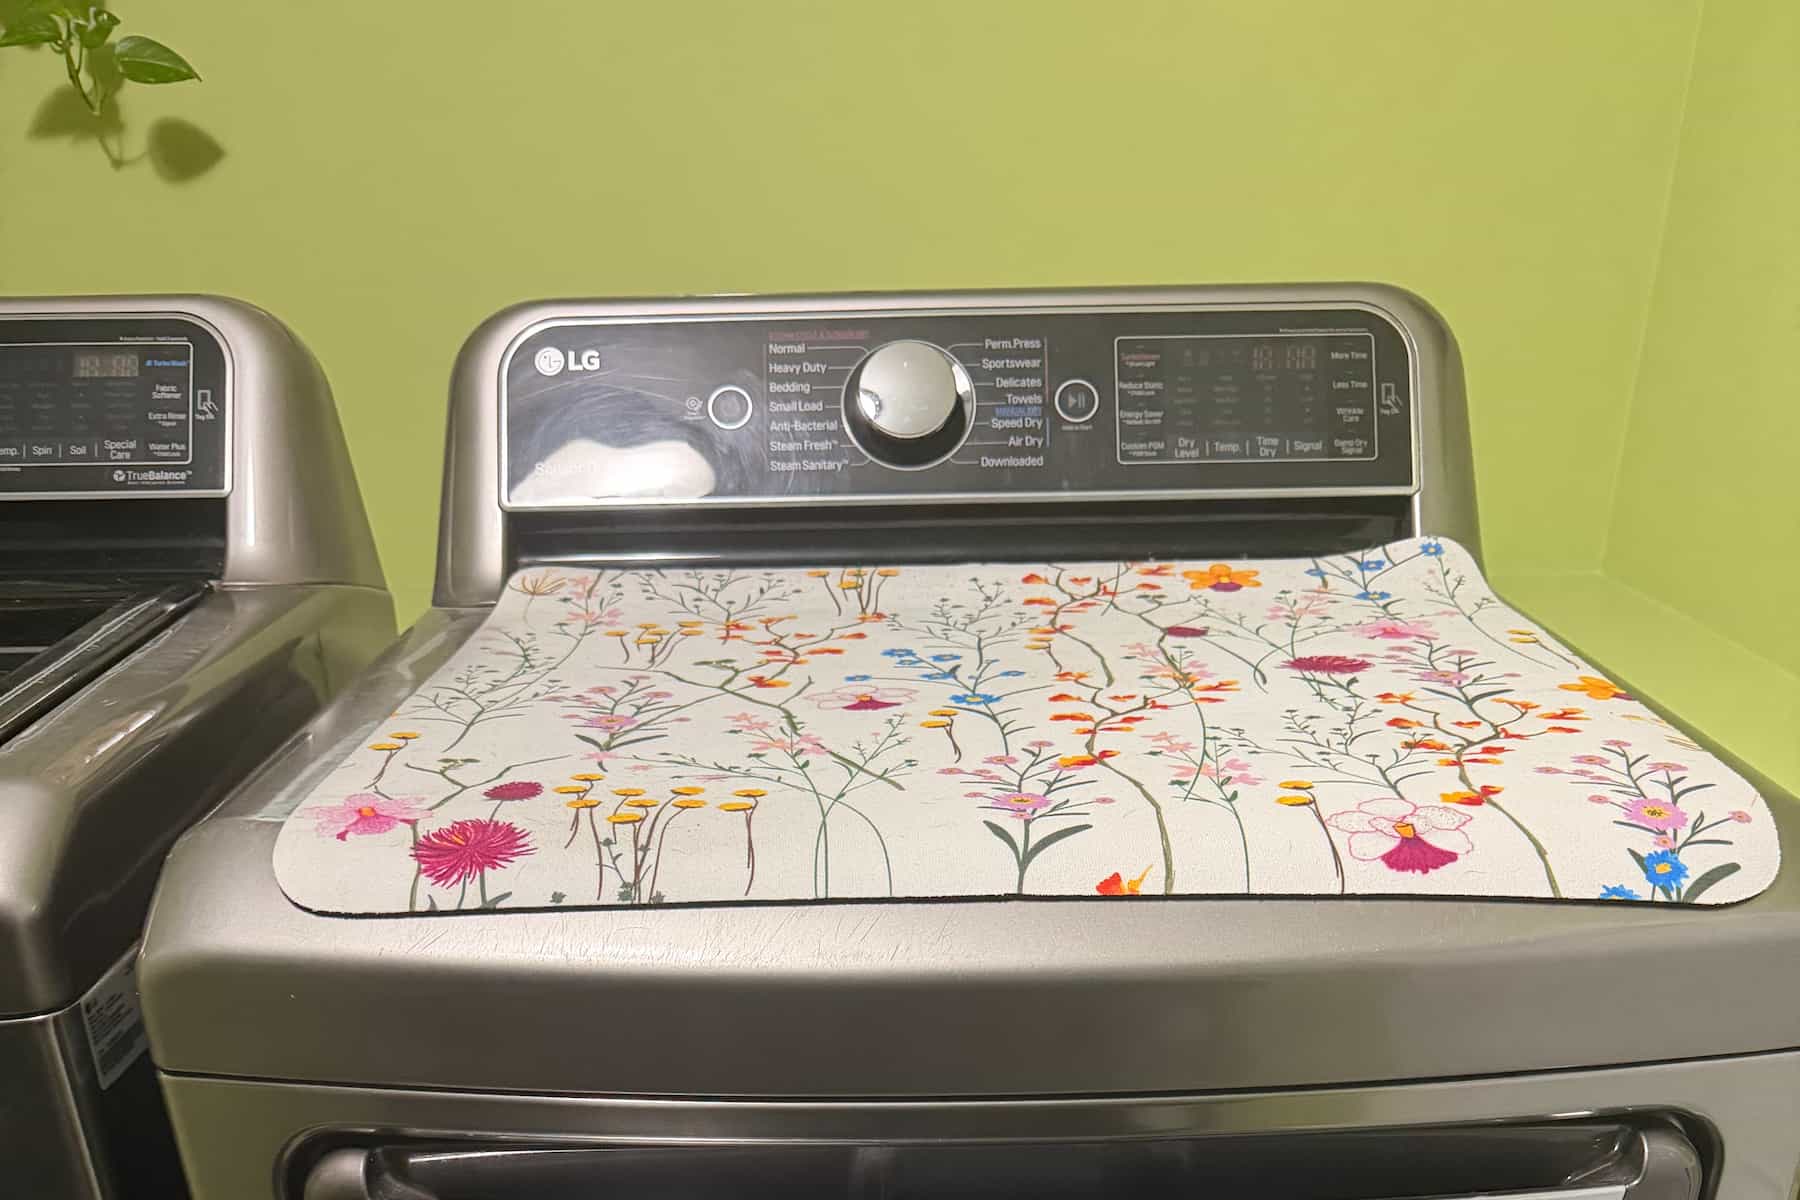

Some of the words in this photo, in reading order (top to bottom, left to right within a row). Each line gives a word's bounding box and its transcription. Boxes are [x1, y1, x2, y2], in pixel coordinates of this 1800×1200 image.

[768, 343, 806, 354] Normal
[568, 350, 600, 371] LG
[982, 358, 1042, 371] Sportswear
[768, 363, 801, 375] Heavy
[802, 362, 827, 374] Duty
[996, 377, 1042, 388] Delicates
[769, 382, 811, 395] Bedding
[1006, 394, 1042, 405] Towels
[769, 401, 798, 412] Small
[799, 400, 823, 411] Load
[769, 420, 838, 432] Anti-Bacterial
[991, 418, 1023, 430] Speed
[1024, 417, 1043, 430] Dry
[104, 440, 137, 451] Special
[769, 441, 802, 452] Steam
[1008, 436, 1022, 447] Air
[1025, 435, 1044, 448] Dry
[1178, 437, 1196, 448] Dry
[1256, 436, 1279, 446] Time
[1294, 441, 1322, 452] Signal
[33, 446, 52, 457] Spin
[70, 445, 87, 454] Soil
[110, 450, 130, 460] Care
[1174, 447, 1200, 458] Level
[1260, 446, 1277, 457] Dry
[770, 461, 802, 472] Steam
[980, 456, 1044, 467] Downloaded
